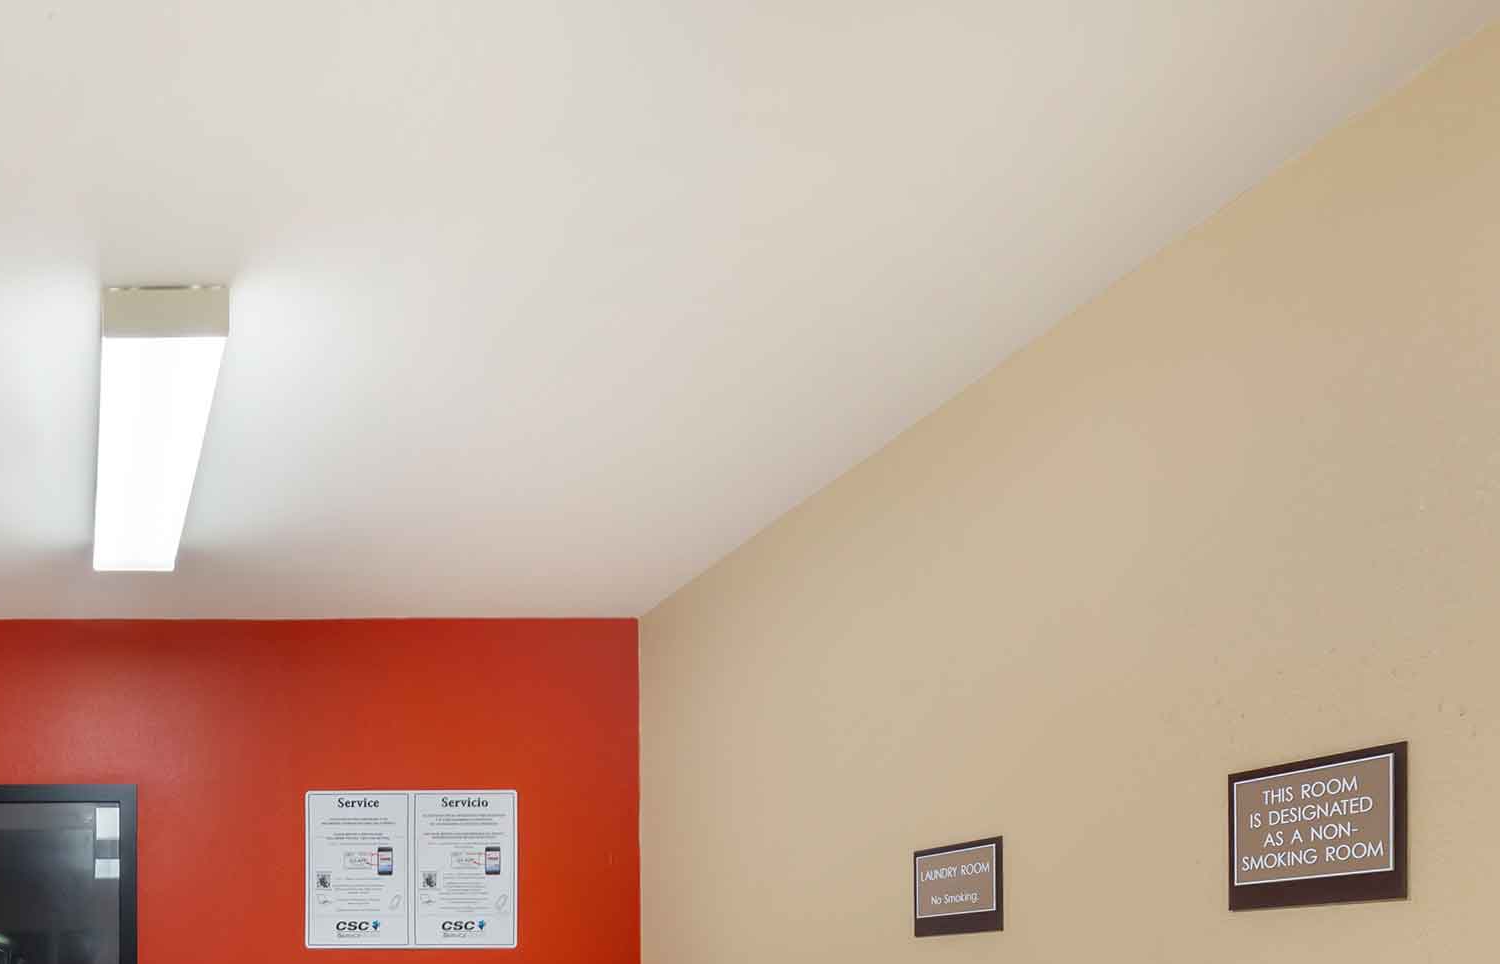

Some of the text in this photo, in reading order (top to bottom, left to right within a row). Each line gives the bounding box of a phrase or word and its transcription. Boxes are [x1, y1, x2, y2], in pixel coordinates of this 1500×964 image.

[1262, 775, 1359, 806] THIS ROOM
[337, 797, 380, 808] Service
[441, 796, 489, 808] Servicio
[1249, 796, 1373, 829] IS DESIGNATED
[1263, 821, 1359, 848] AS A NON-
[1241, 839, 1384, 872] SMOKING ROOM
[920, 861, 990, 883] LAUNDRY ROOM
[931, 891, 978, 905] No Smoking
[336, 920, 370, 931] CSC
[441, 920, 475, 931] CSC
